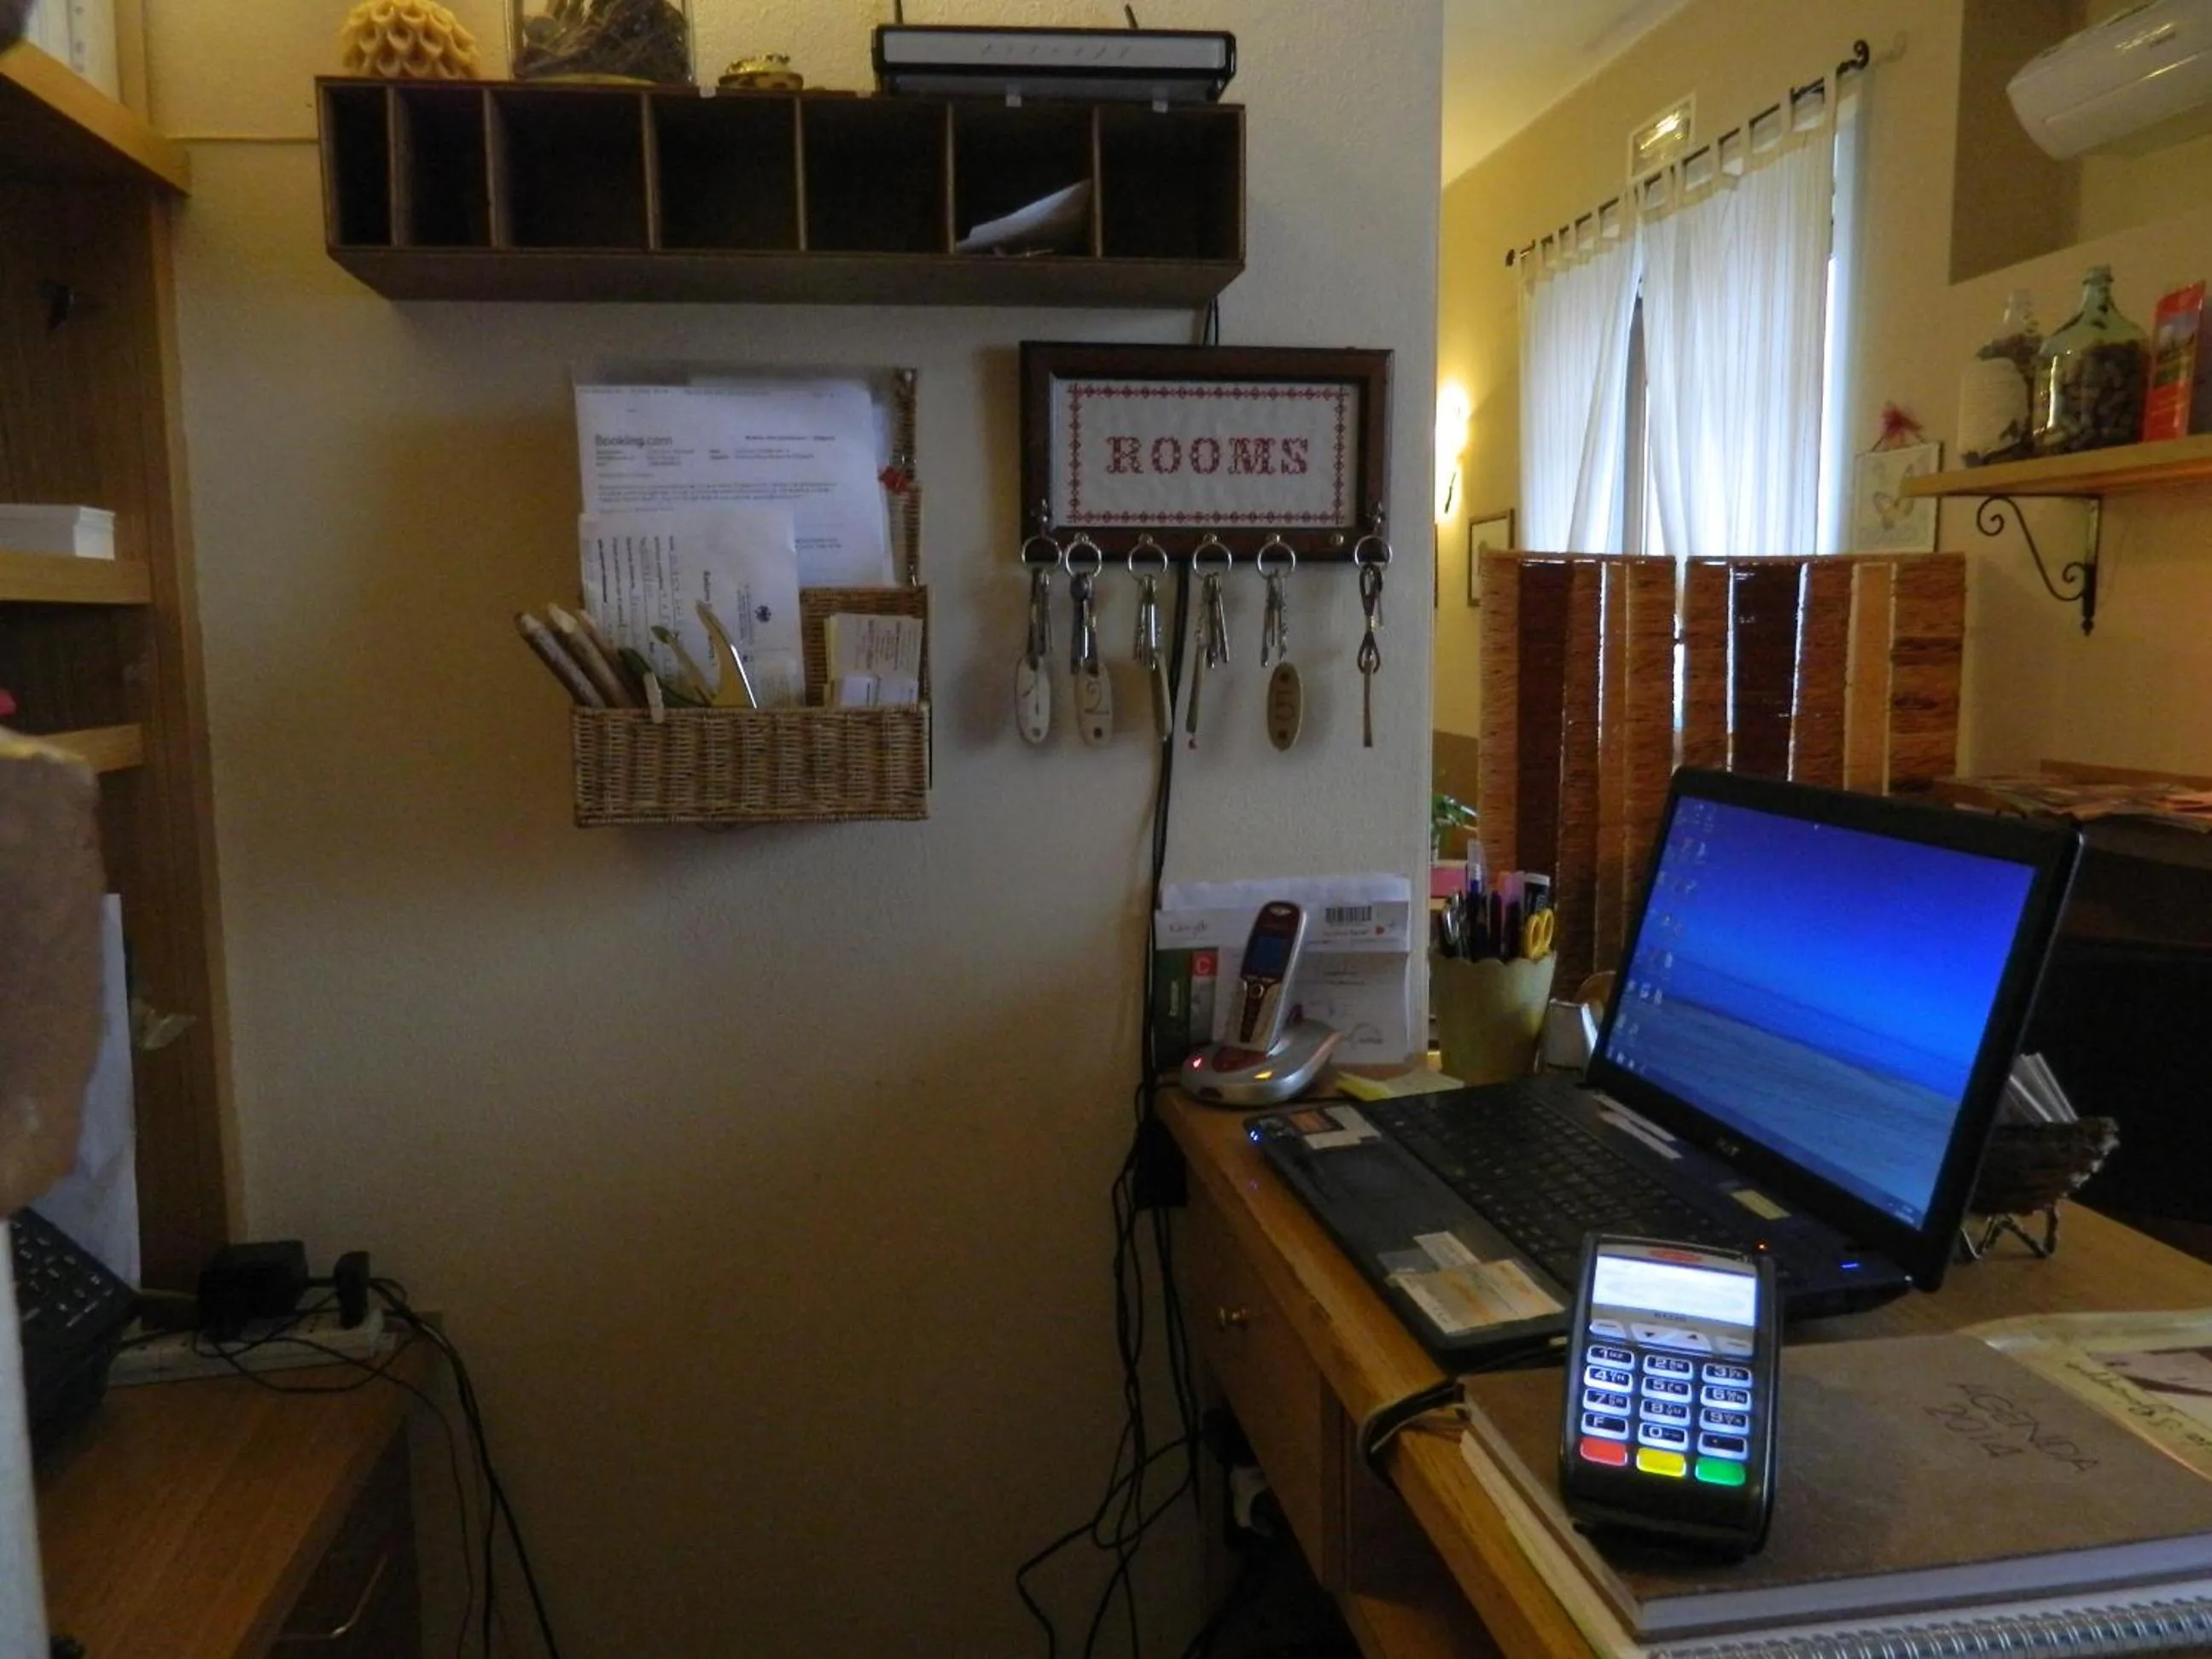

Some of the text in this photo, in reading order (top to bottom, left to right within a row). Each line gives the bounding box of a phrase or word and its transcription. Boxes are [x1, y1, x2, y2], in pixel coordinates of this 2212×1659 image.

[594, 433, 672, 449] Booking.com
[1105, 435, 1309, 476] ROOMS
[1084, 681, 1110, 715] 2
[1655, 1357, 1666, 1369] 2
[1594, 1370, 1608, 1381] 4
[1714, 1365, 1726, 1377] 3
[1653, 1379, 1665, 1391] 5
[1595, 1393, 1607, 1405] 7
[1712, 1388, 1725, 1400] 6
[1651, 1403, 1663, 1414] 8
[1710, 1412, 1723, 1423] 9
